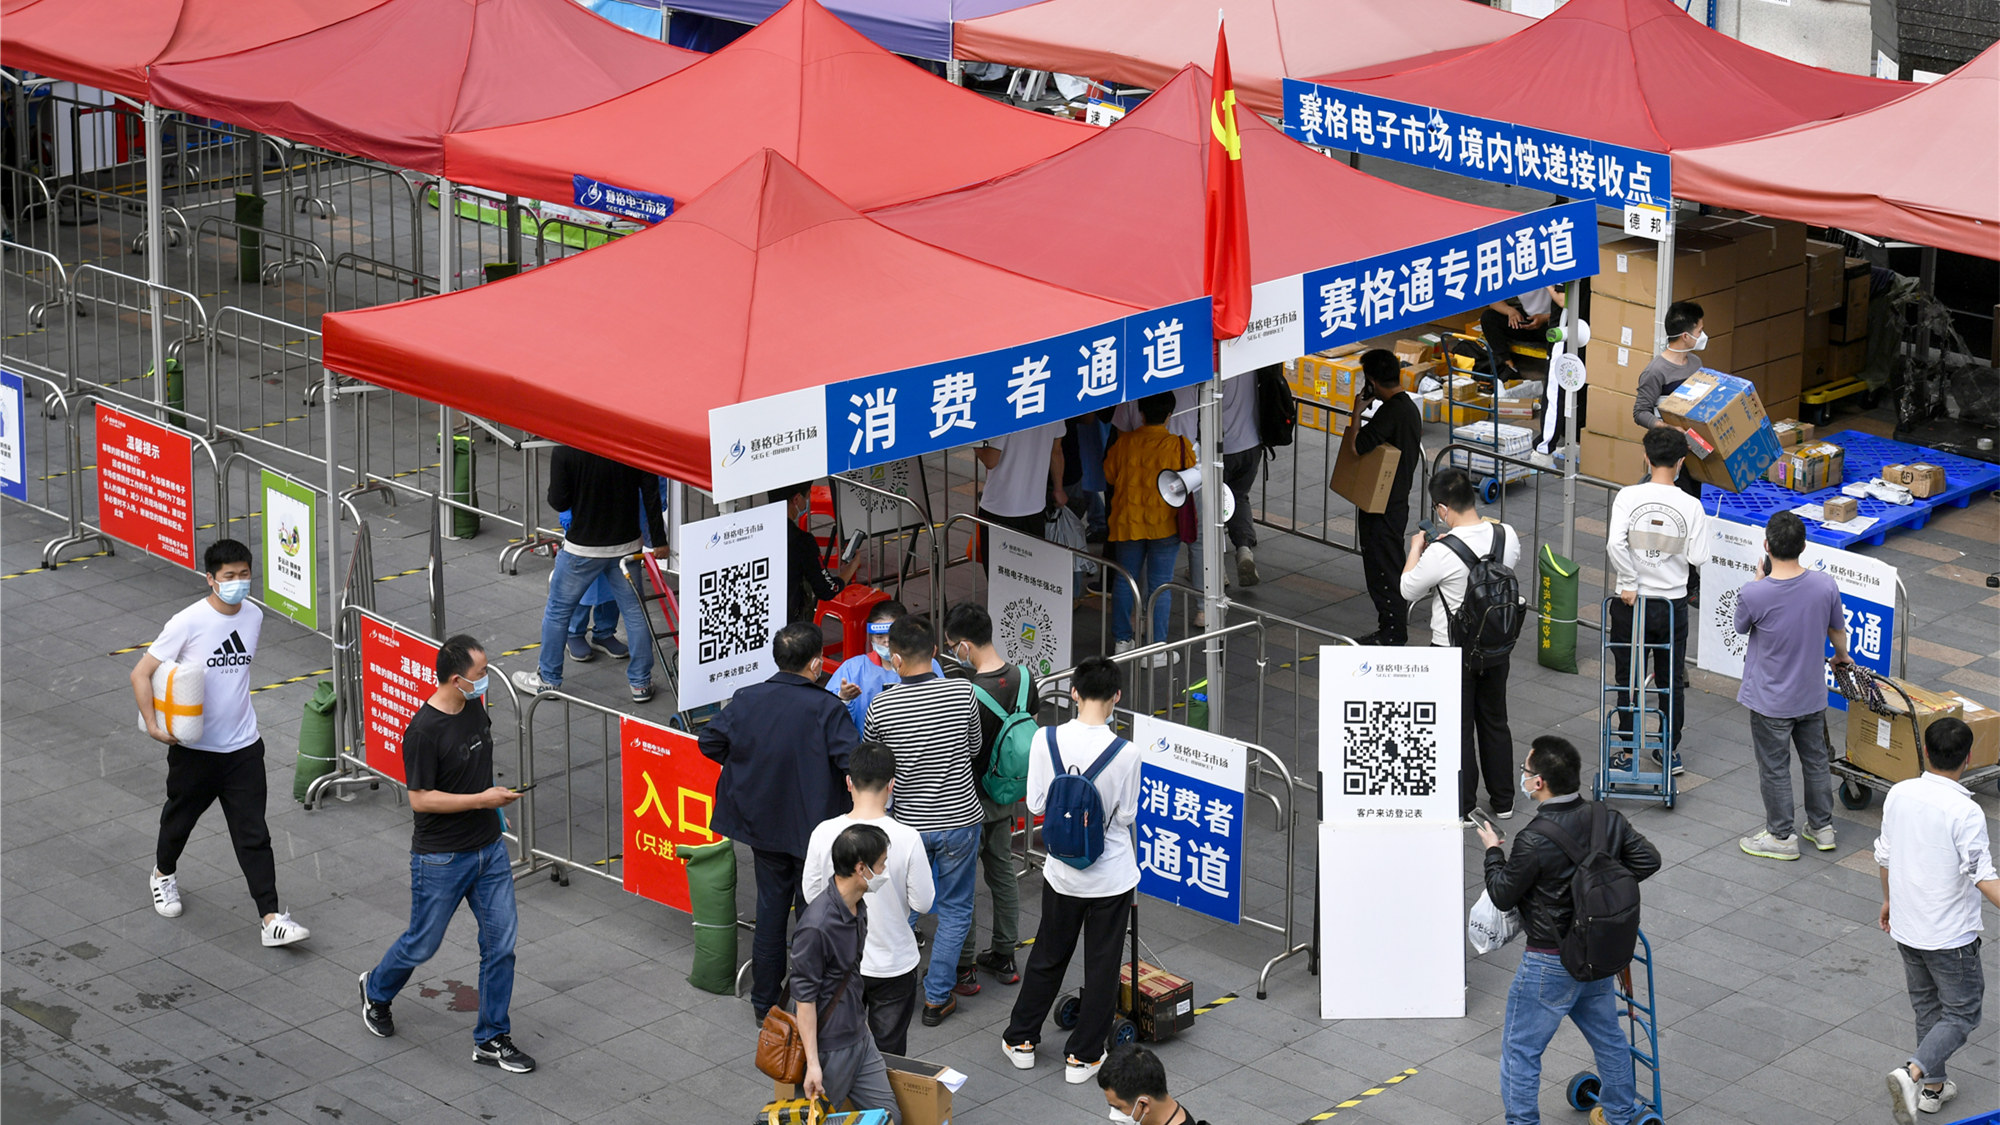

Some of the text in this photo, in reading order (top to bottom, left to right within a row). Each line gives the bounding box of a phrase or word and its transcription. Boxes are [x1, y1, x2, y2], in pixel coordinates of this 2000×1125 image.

[1299, 93, 1654, 204] 赛格电子市场 境内快递接收点
[605, 189, 666, 217] 赛格电子市场
[1319, 217, 1577, 338] 赛格通专用通道
[1247, 310, 1297, 333] 赛格电子市场
[847, 317, 1185, 456] 消费者通道
[126, 434, 160, 459] 温馨提示
[750, 426, 817, 452] 赛格电子市场
[997, 565, 1063, 595] 赛格电子市场华强北店
[1830, 564, 1880, 586] 赛格电子市场
[206, 653, 252, 667] adidas
[709, 661, 759, 683] 客户来访登记表
[1174, 743, 1229, 769] 赛格电子市场
[633, 770, 714, 842] 入口
[1141, 776, 1234, 838] 消费者
[1357, 808, 1423, 818] 客户来访登记表
[1139, 823, 1231, 899] 通道
